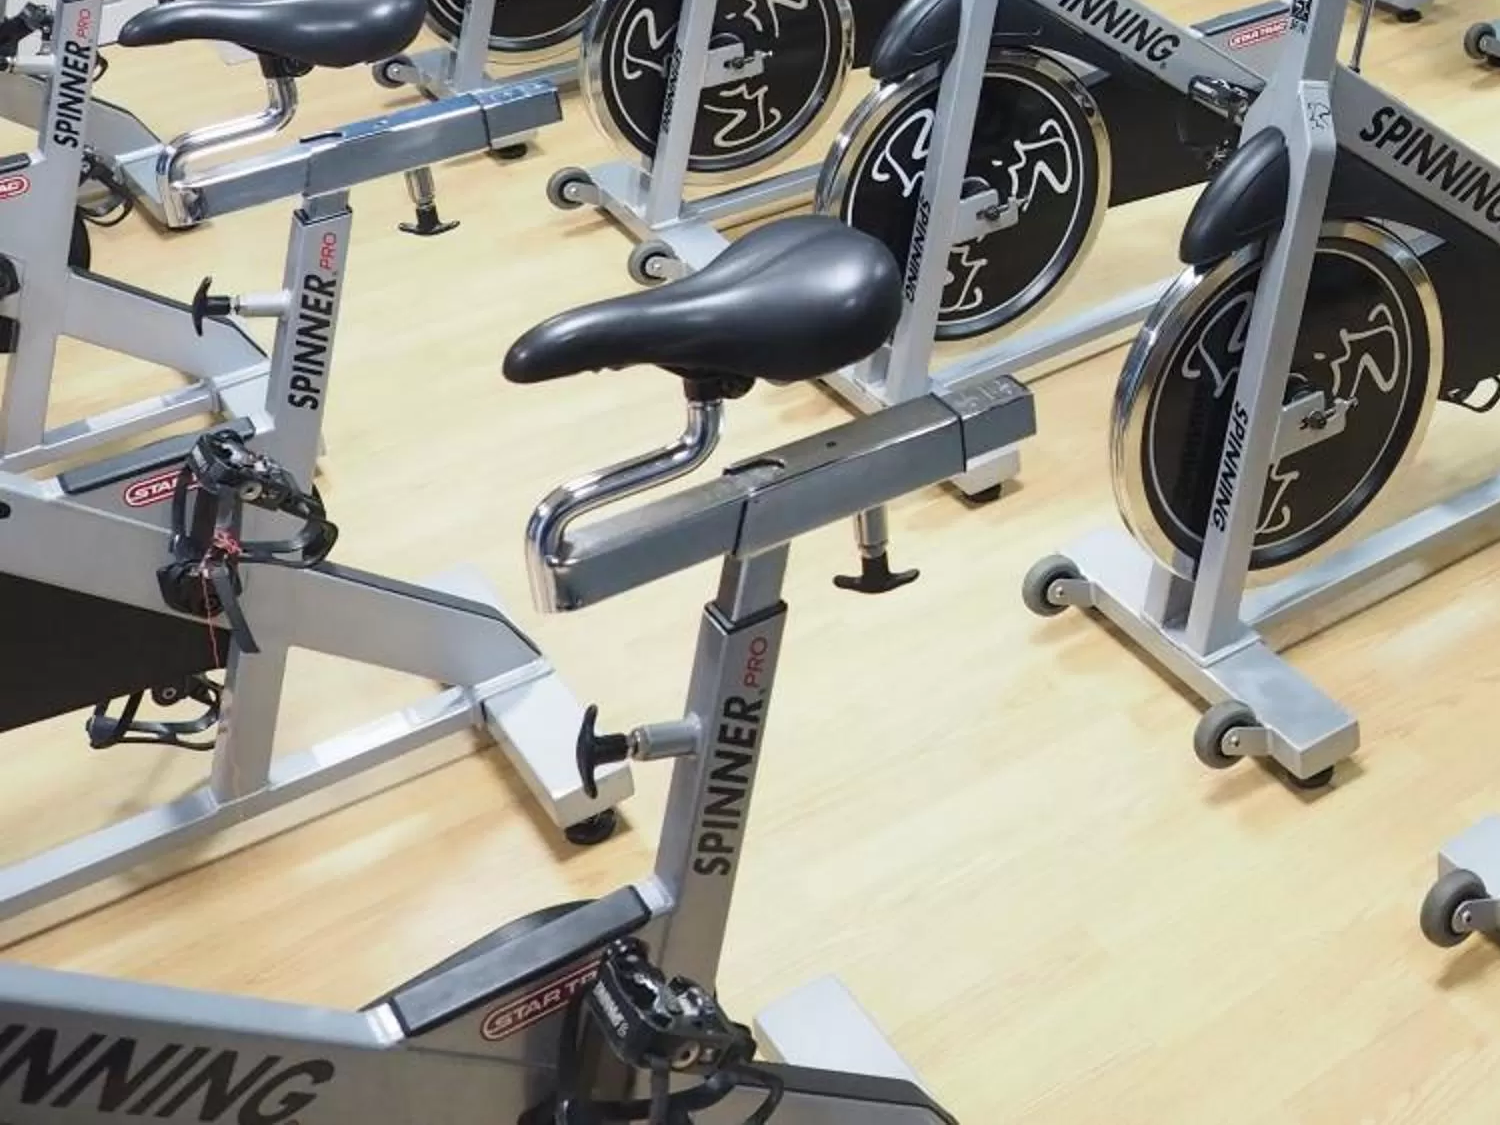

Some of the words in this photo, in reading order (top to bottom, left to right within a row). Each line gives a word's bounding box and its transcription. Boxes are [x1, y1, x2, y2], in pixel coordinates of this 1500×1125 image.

[53, 40, 91, 148] SPINNER
[319, 231, 337, 270] PRO
[902, 196, 932, 304] SPINNING
[287, 273, 337, 410] SPINNER
[1212, 398, 1249, 533] SPINNING
[743, 635, 768, 689] PRO
[693, 695, 763, 876] SPINNER
[488, 988, 561, 1035] STAR
